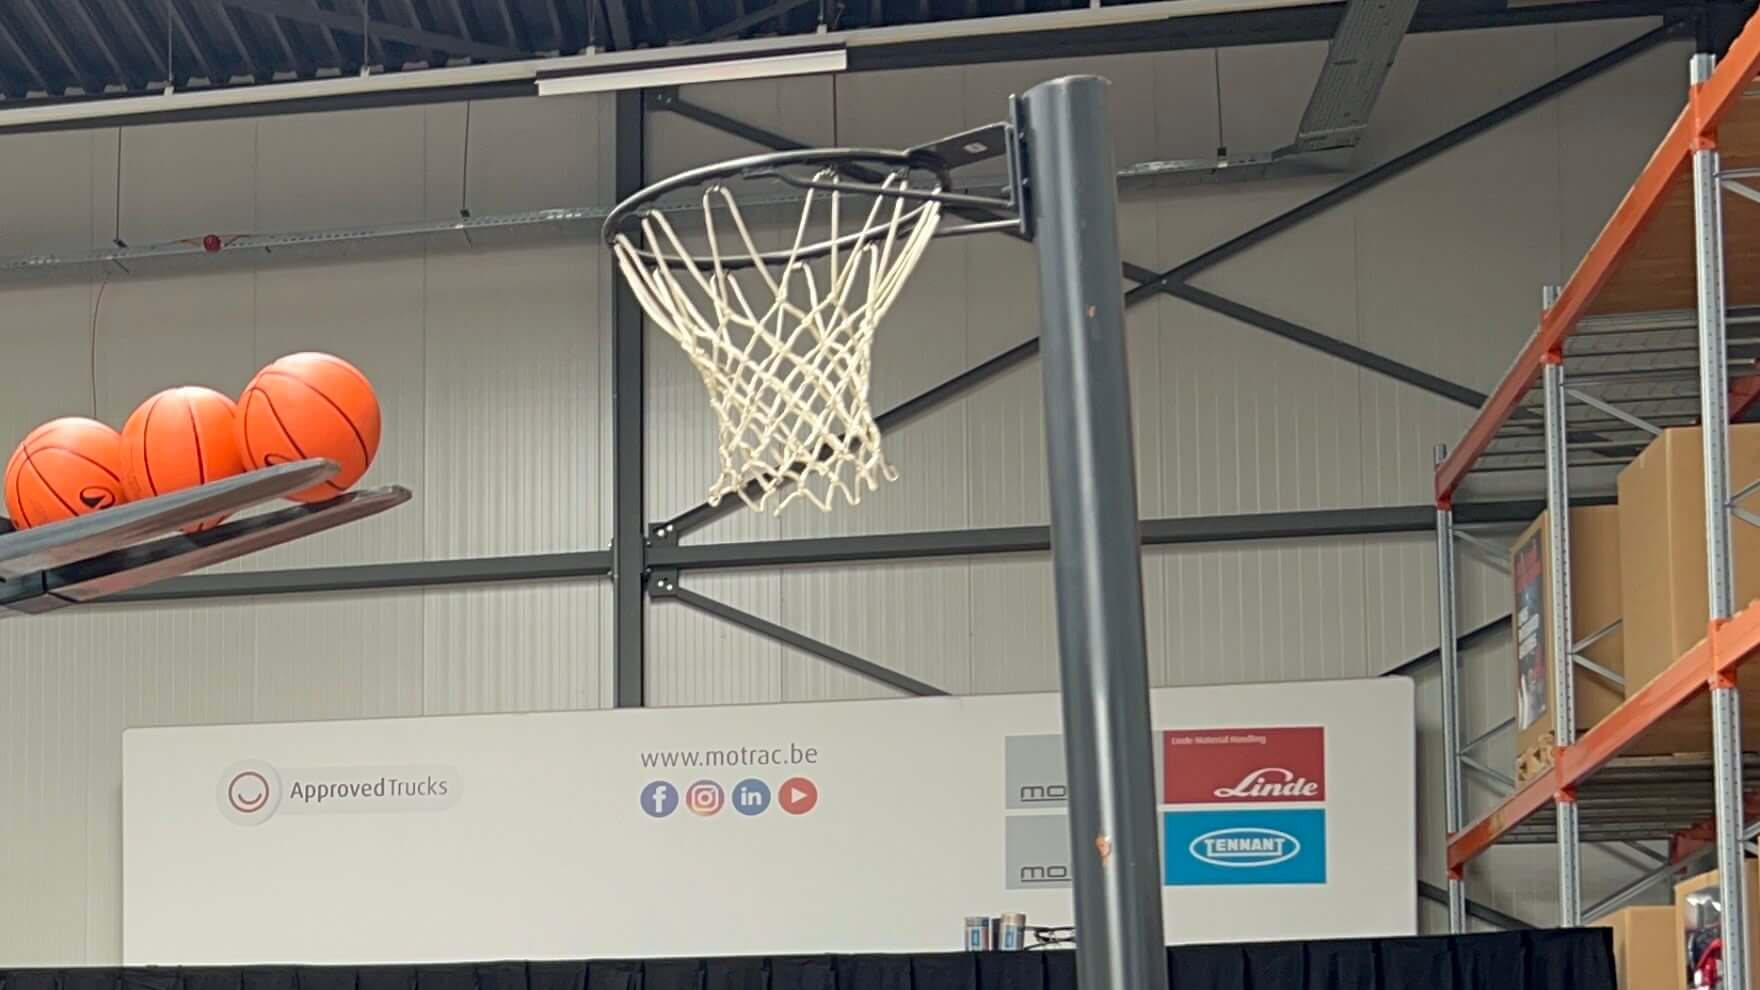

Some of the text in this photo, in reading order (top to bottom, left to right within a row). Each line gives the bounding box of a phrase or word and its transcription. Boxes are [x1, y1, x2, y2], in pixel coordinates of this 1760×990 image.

[640, 743, 818, 768] www.motrac.be
[1213, 767, 1318, 798] Linde
[1204, 838, 1286, 857] TENNANT
